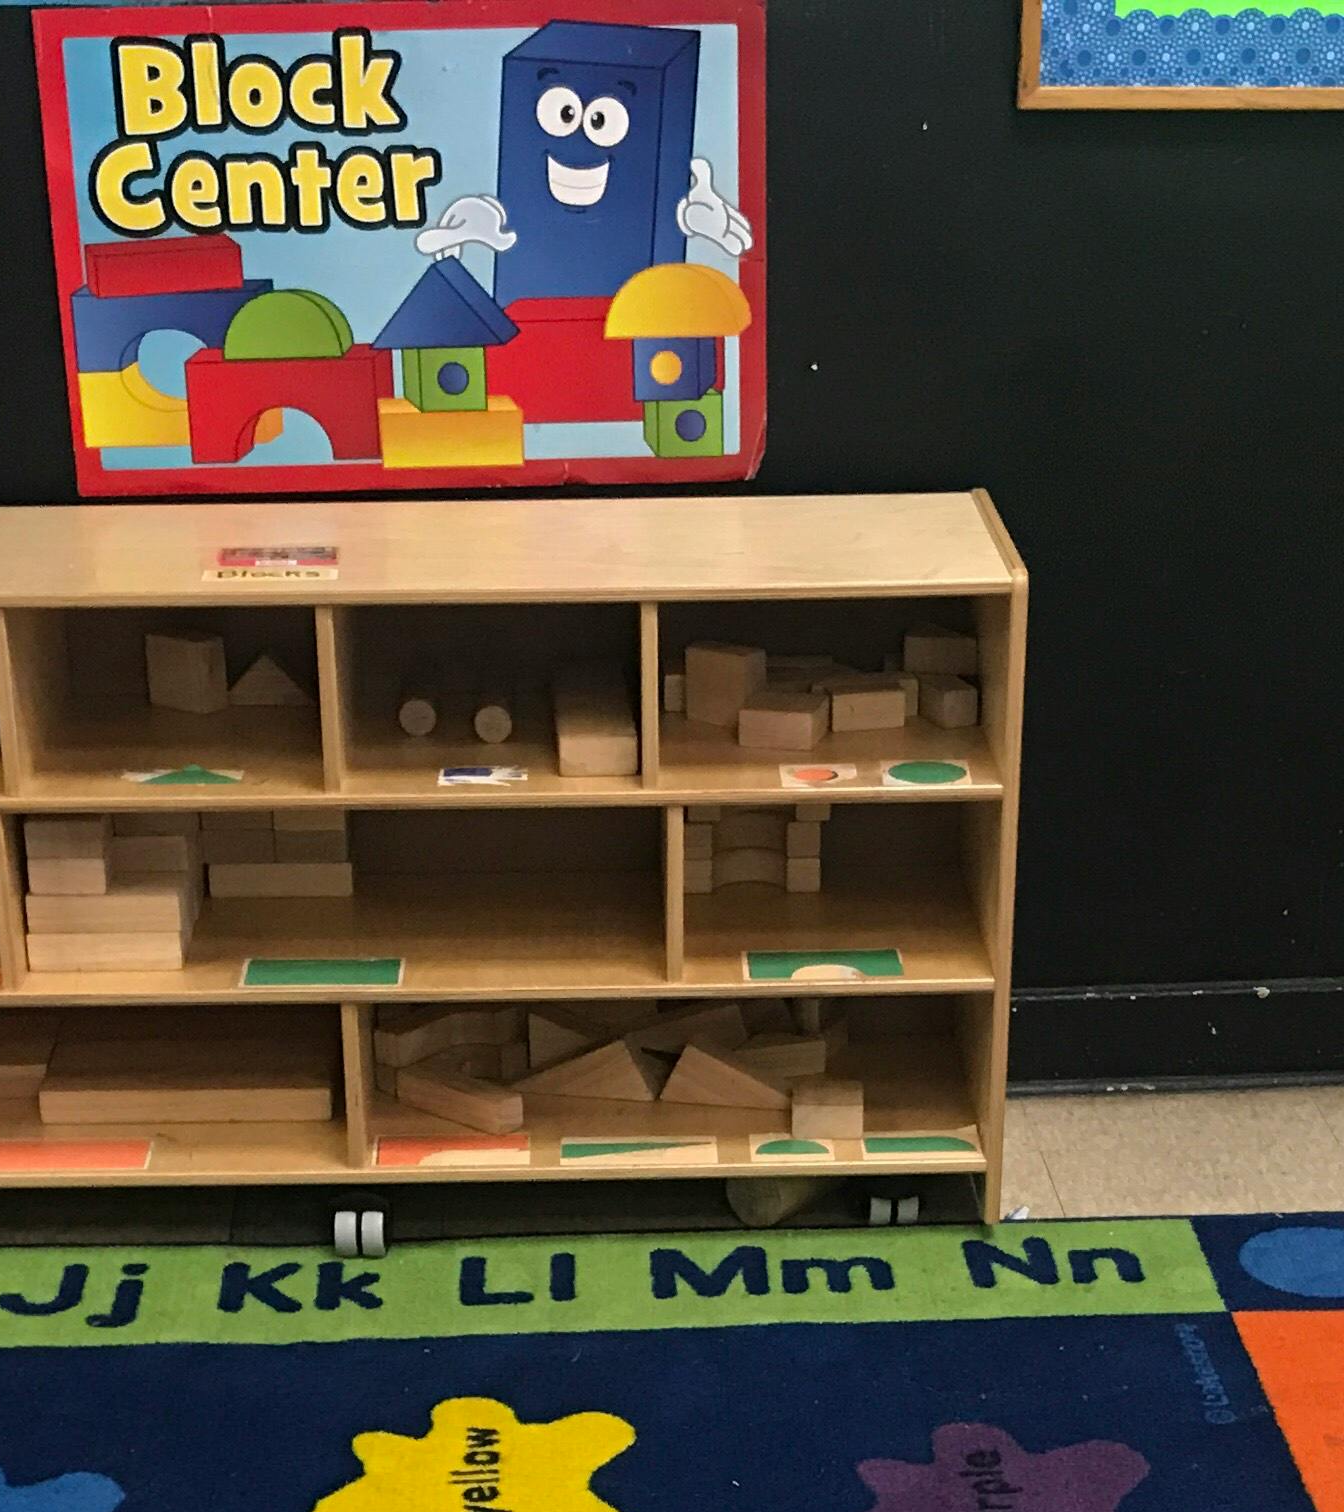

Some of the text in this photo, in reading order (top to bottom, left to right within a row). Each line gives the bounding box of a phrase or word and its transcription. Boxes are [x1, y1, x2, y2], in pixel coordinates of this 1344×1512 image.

[114, 31, 404, 137] Block
[92, 141, 438, 233] Center
[217, 1261, 384, 1313] Kk
[650, 1244, 894, 1299] Mm
[963, 1236, 1145, 1289] Nn
